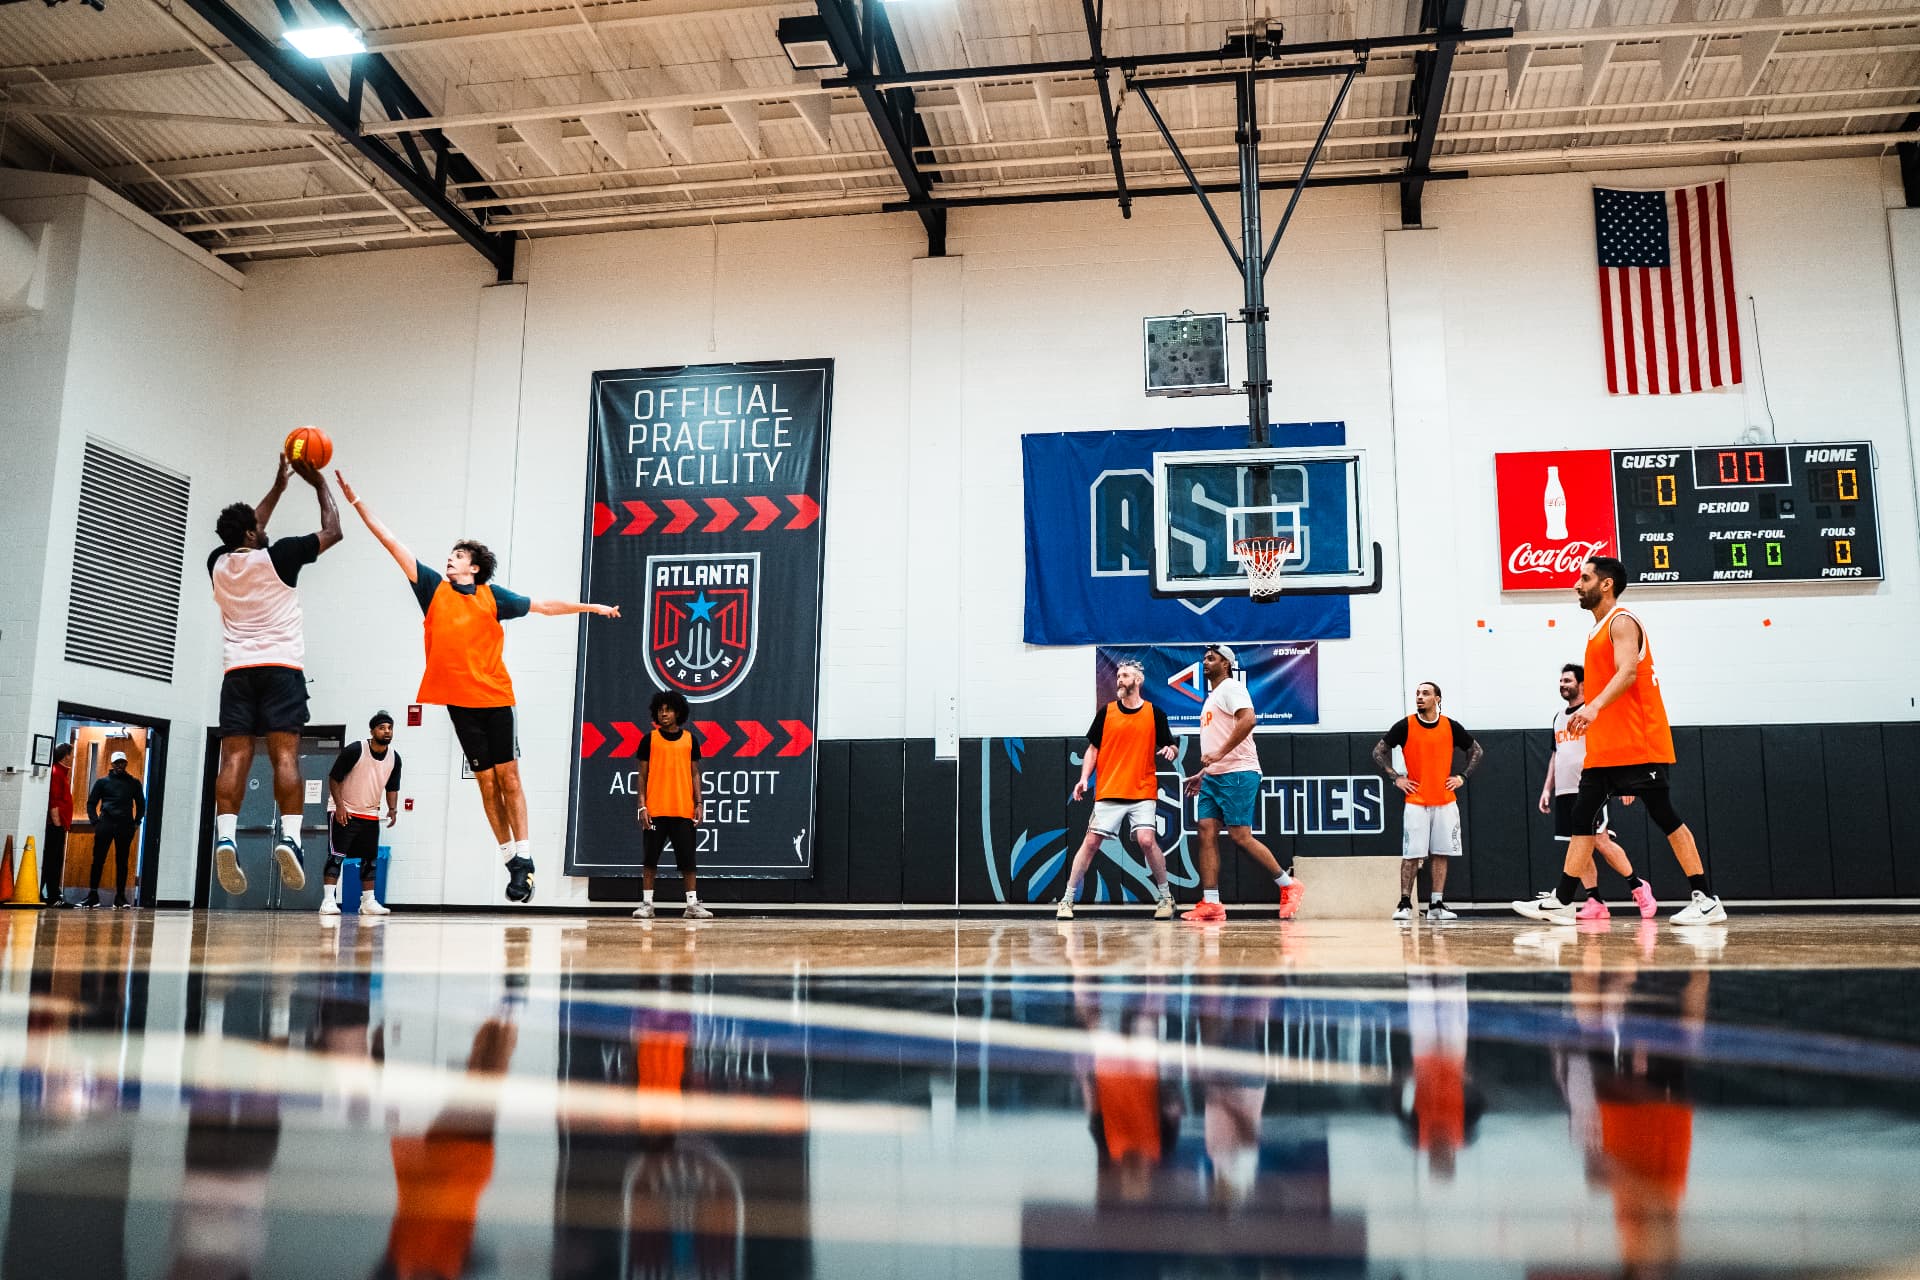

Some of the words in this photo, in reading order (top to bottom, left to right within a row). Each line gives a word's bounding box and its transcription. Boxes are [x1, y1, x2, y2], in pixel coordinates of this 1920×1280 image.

[634, 384, 789, 420] OFFICIAL
[628, 417, 793, 453] PRACTICE
[1621, 454, 1680, 469] GUEST
[1804, 448, 1858, 463] HOME
[635, 452, 782, 487] FACILITY
[1656, 475, 1677, 506] 0
[1837, 469, 1859, 500] 0
[1697, 501, 1750, 514] PERIOD
[1639, 532, 1675, 542] FOULS
[1708, 529, 1786, 540] PLAYER-FOUL
[1820, 526, 1856, 537] FOULS
[1508, 541, 1608, 574] Coca-Col
[1653, 545, 1670, 568] 0
[1731, 543, 1748, 566] 0
[1765, 542, 1782, 566] 0
[1835, 540, 1852, 564] 0
[656, 564, 749, 587] ATLANTA
[1639, 570, 1680, 581] POINTS
[1712, 569, 1753, 580] MATCH
[1821, 566, 1863, 577] POINTS
[665, 656, 734, 684] DREAM
[701, 770, 780, 795] SCOTT
